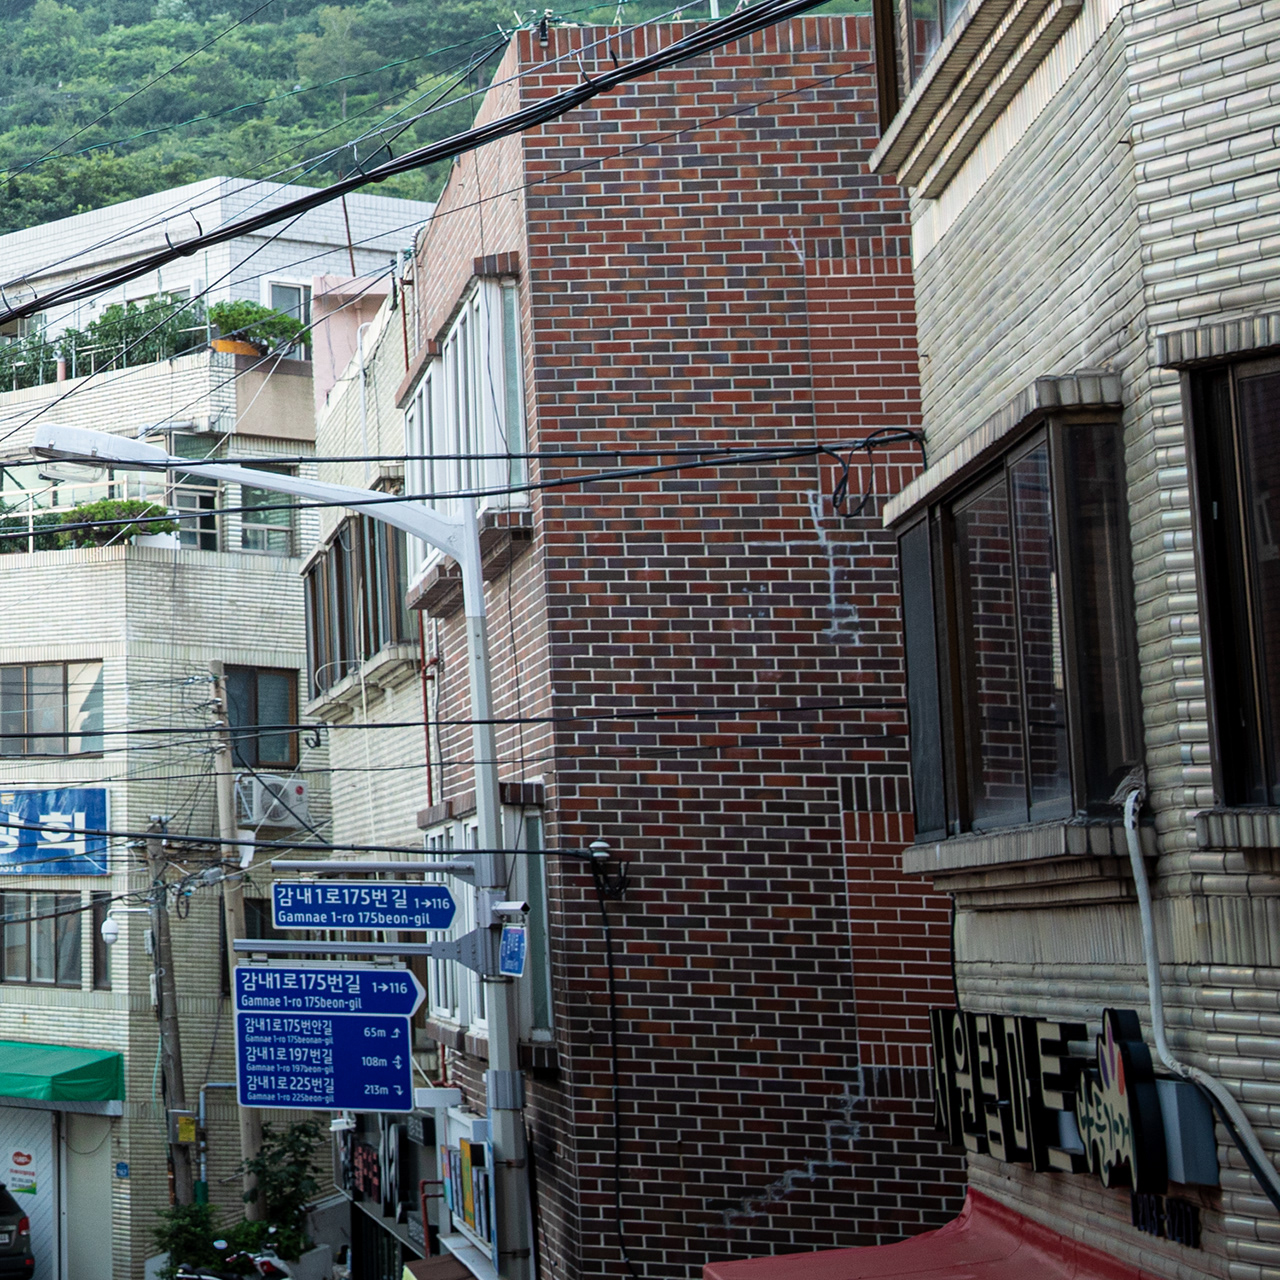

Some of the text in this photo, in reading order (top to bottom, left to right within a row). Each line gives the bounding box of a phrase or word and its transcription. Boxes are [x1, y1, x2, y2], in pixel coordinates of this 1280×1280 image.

[277, 888, 450, 909] 감내1로175번길 1 116
[278, 911, 430, 926] Gamnae 1-ro 175beon-gil
[242, 972, 408, 993] 감내1로175번길 1 116
[242, 995, 362, 1010] Gamnae 1-ro 175beon-gil
[245, 1018, 386, 1037] 감내1로175번안길 65m
[245, 1035, 271, 1043] Gamnae
[273, 1035, 286, 1043] 1-ro
[246, 1047, 387, 1067] 감내1로197번길 108m
[246, 1063, 275, 1071] Gamnae
[247, 1076, 389, 1095] 감내1로225번길 213m
[248, 1092, 275, 1100] Gamnae
